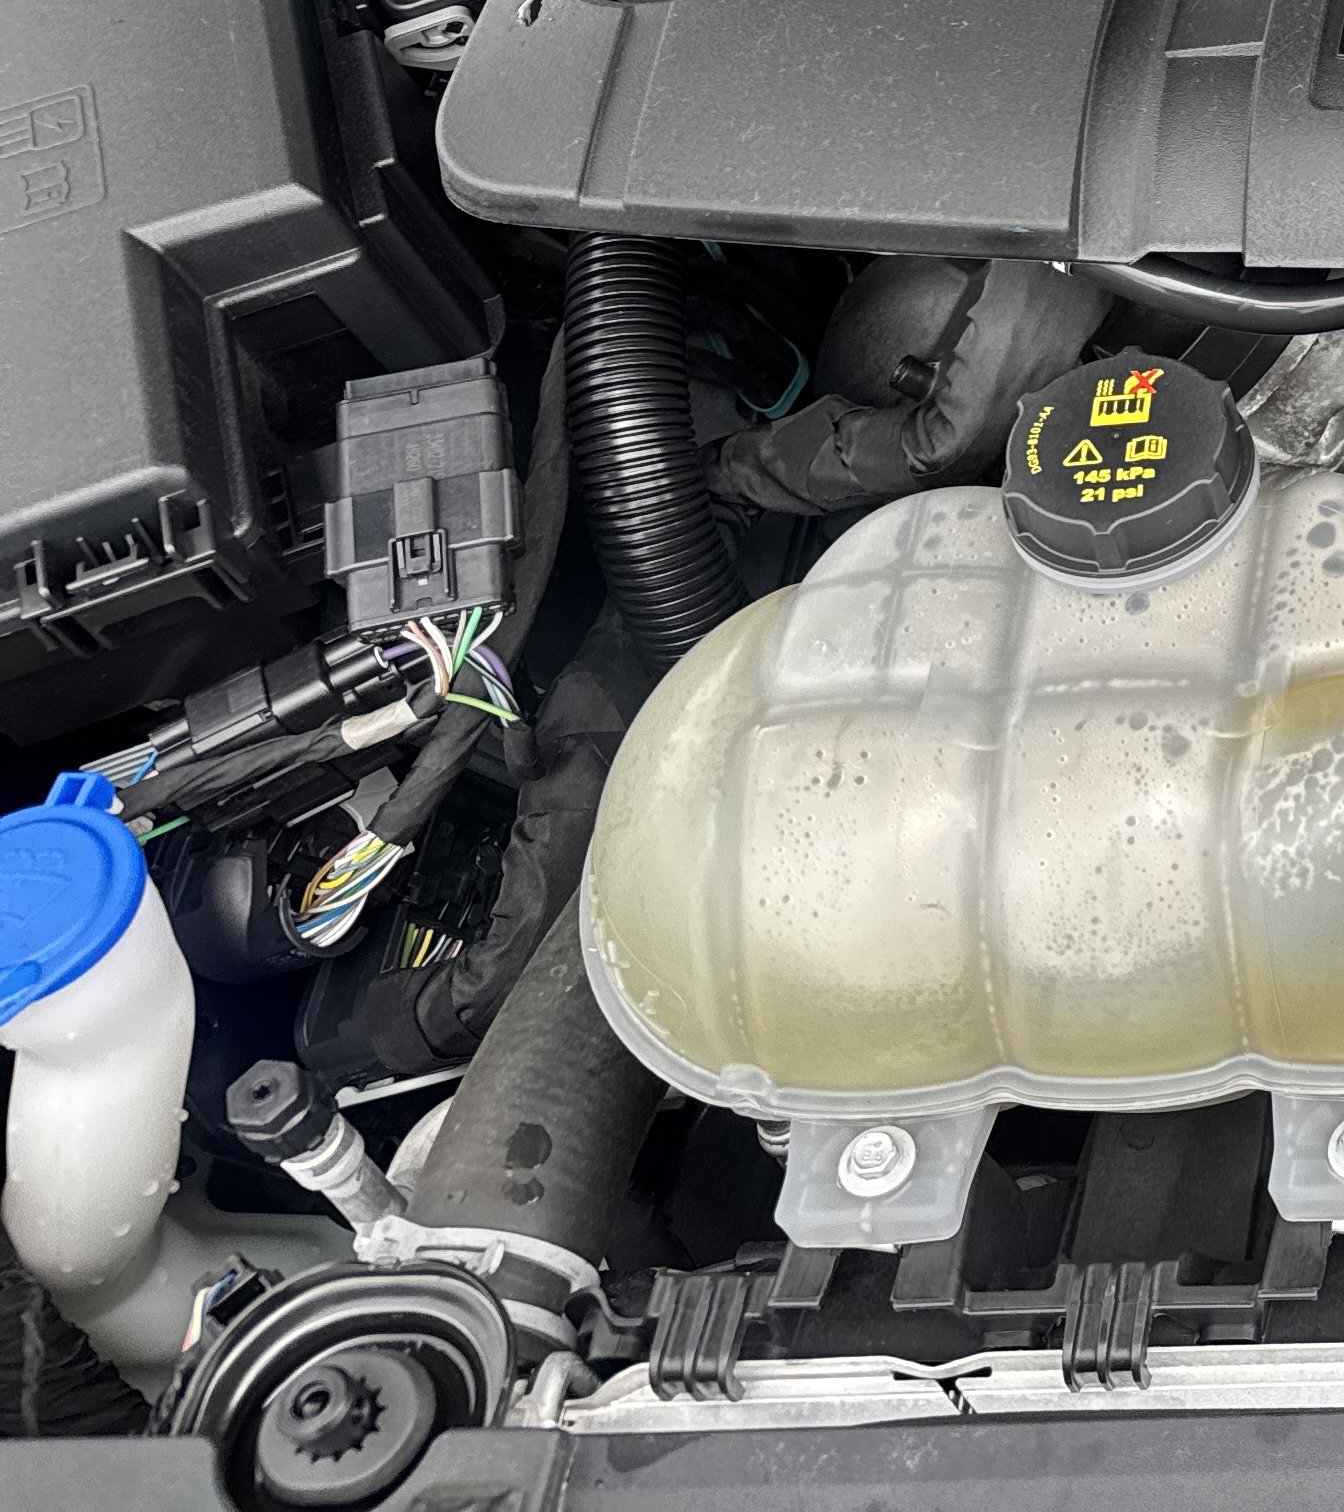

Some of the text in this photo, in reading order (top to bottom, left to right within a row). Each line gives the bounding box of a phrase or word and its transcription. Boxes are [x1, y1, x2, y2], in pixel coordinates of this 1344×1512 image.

[1073, 466, 1156, 485] 145 kPa
[1080, 484, 1144, 503] 21 psi
